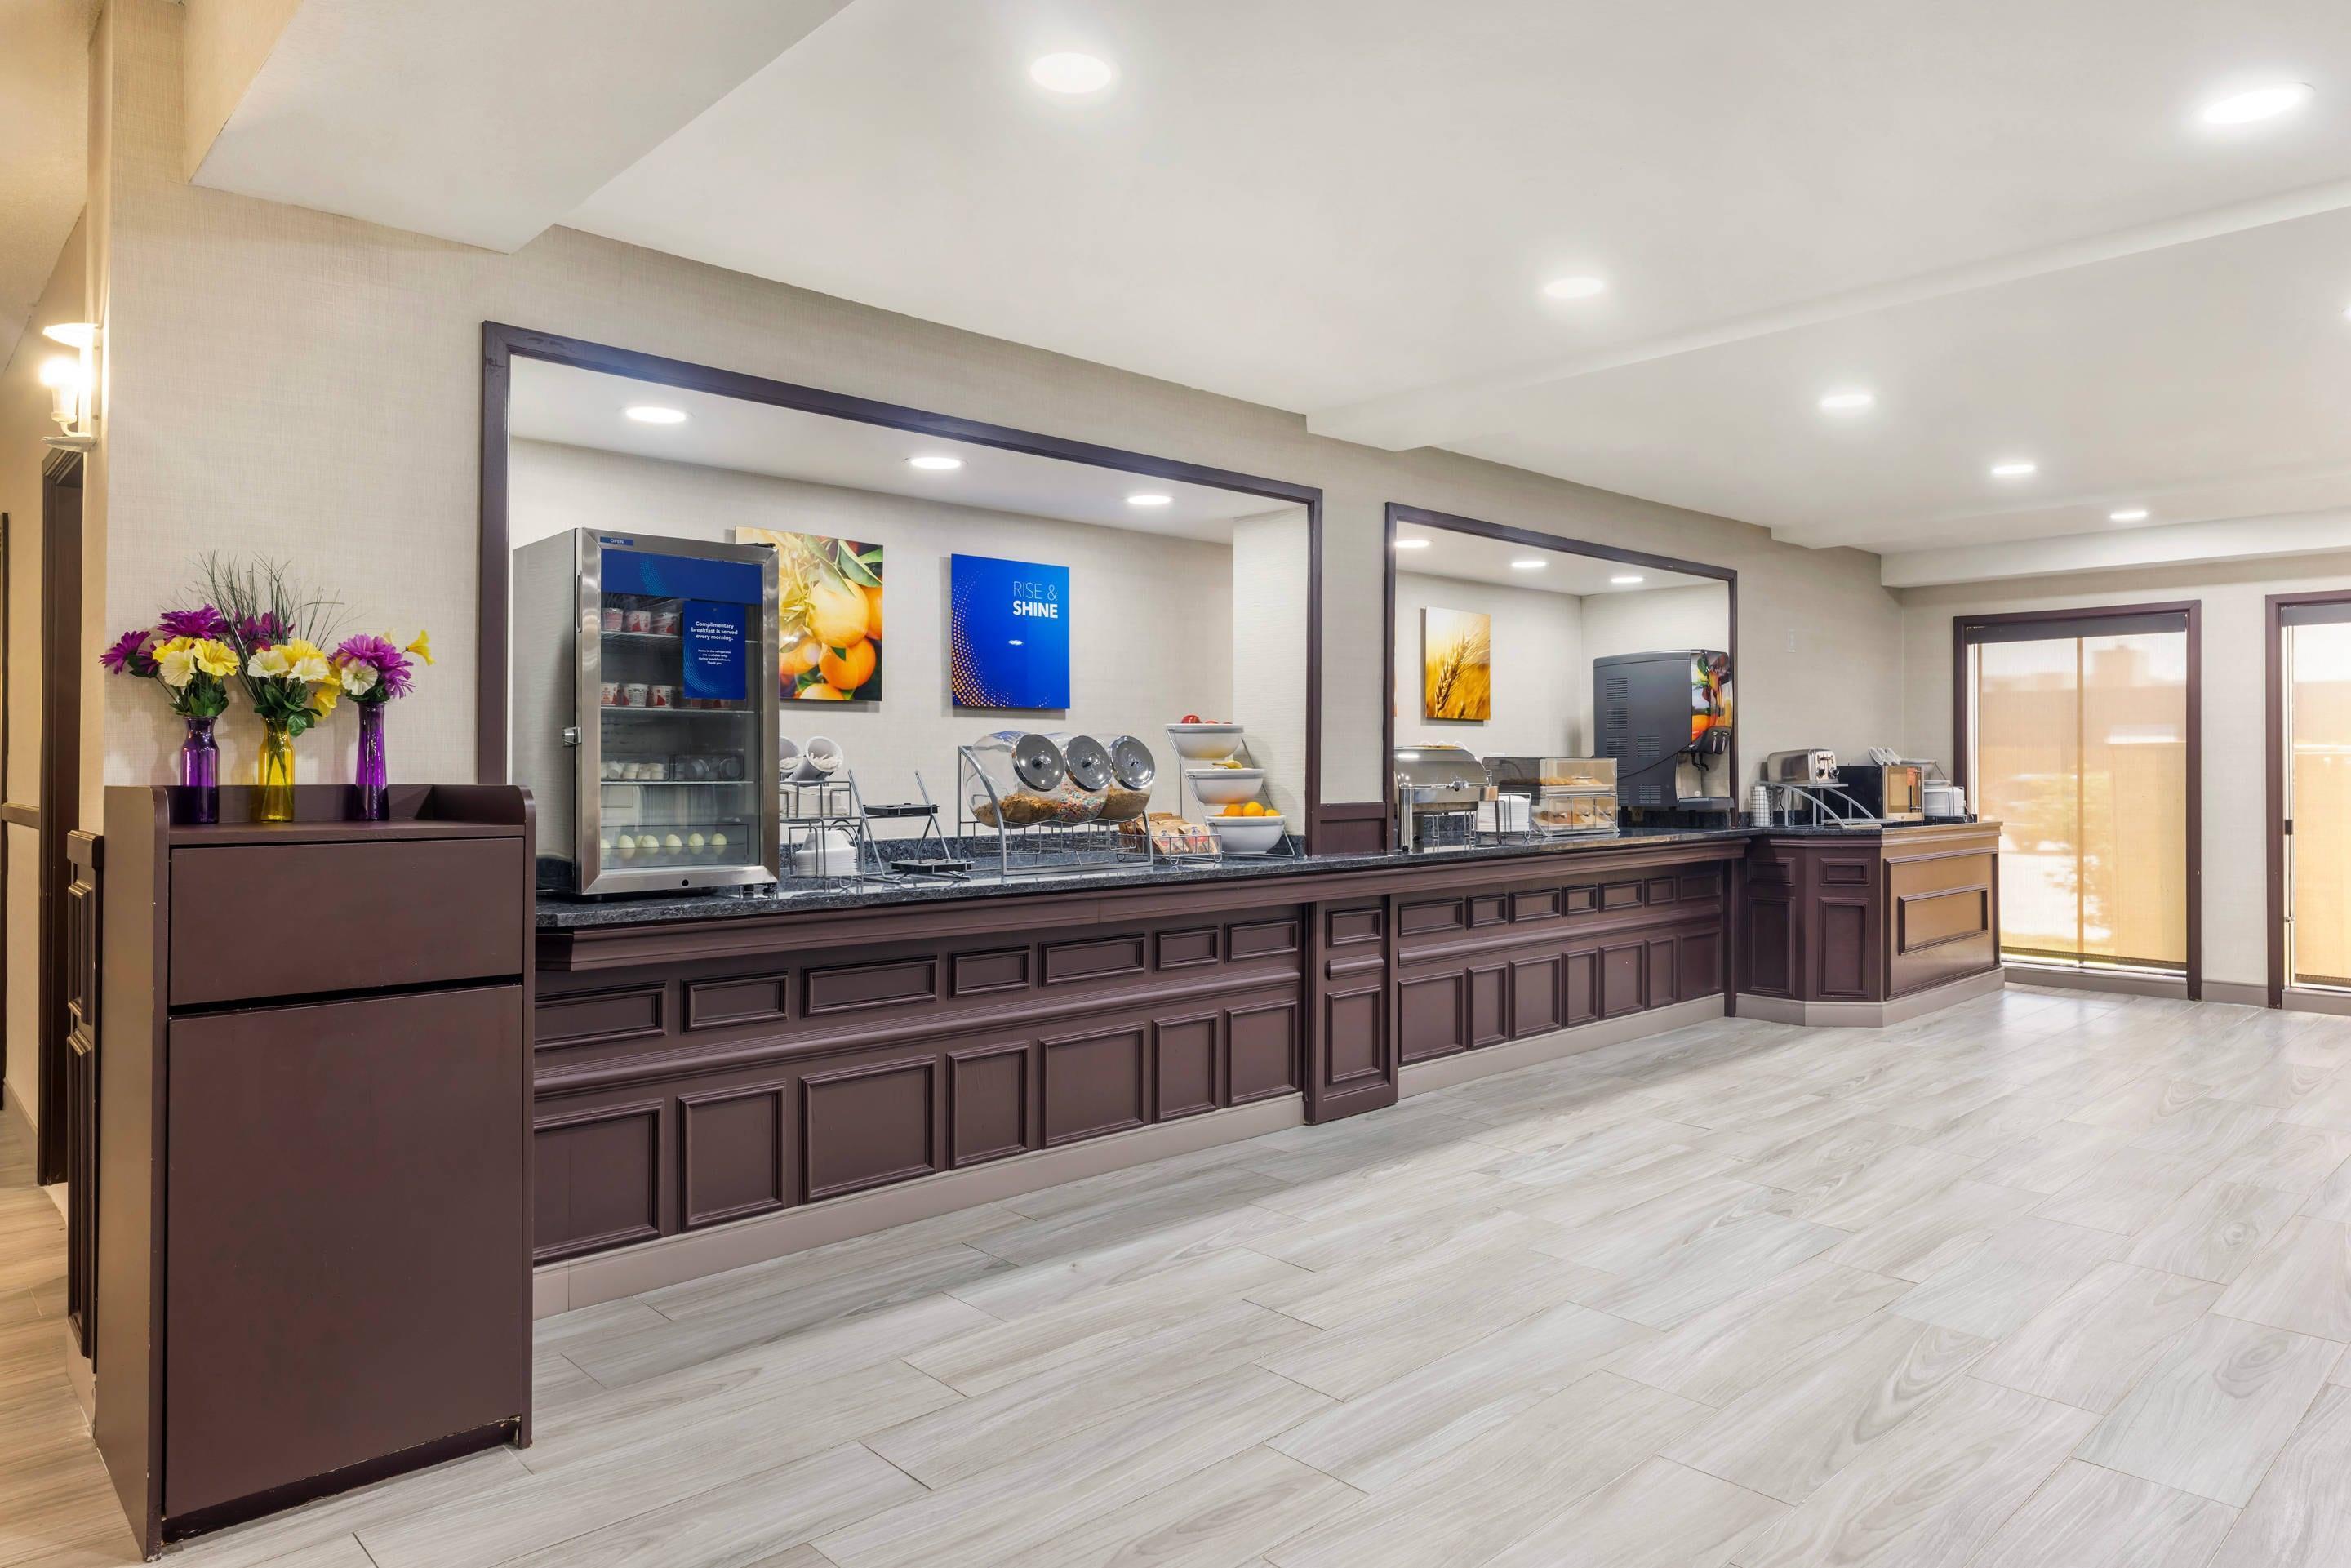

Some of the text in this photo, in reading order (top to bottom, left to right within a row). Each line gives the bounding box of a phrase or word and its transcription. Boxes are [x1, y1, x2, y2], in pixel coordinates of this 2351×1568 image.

[1013, 580, 1058, 601] RISE &
[1012, 600, 1059, 619] SHINE
[695, 621, 734, 629] Complimentary
